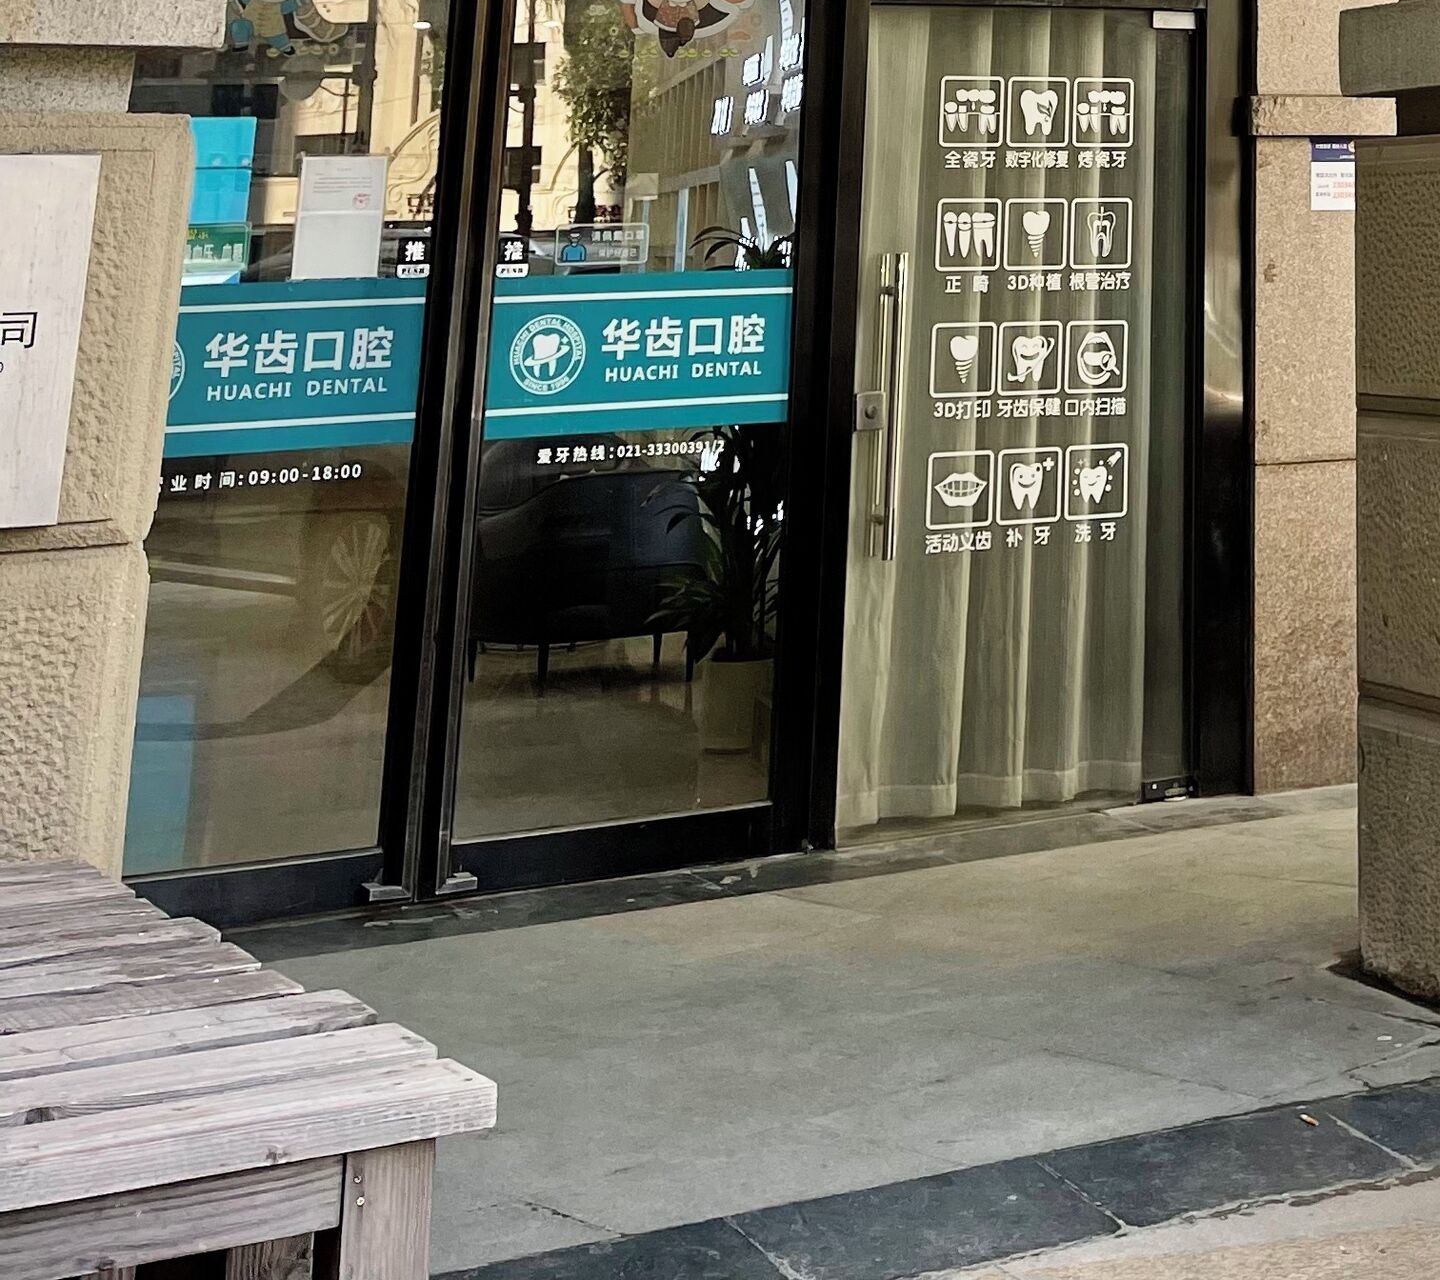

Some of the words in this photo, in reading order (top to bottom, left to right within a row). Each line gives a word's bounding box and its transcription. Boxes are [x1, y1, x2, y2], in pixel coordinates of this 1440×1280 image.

[944, 150, 997, 169] 全瓷牙
[1005, 150, 1069, 169] 数字化修复
[1077, 151, 1127, 169] 烤瓷牙
[404, 240, 426, 262] 推
[504, 240, 524, 262] 推
[1007, 273, 1062, 291] 3D种植
[1069, 272, 1131, 291] 根管治疗
[601, 313, 766, 361] 华齿口腔
[203, 325, 394, 378] 华齿口腔
[604, 363, 679, 383] HUACHI
[691, 360, 762, 378] DENTAL
[206, 381, 292, 402] HUACHI
[306, 377, 388, 397] DENTAL
[933, 399, 991, 420] 3D打印
[996, 398, 1062, 418] 牙齿保健
[1064, 397, 1127, 417] 口内扫描
[160, 463, 362, 492] 业时间:09:00-18:00
[924, 530, 992, 555] 活动义齿
[1006, 525, 1051, 548] 补牙
[1074, 521, 1117, 543] 洗牙
